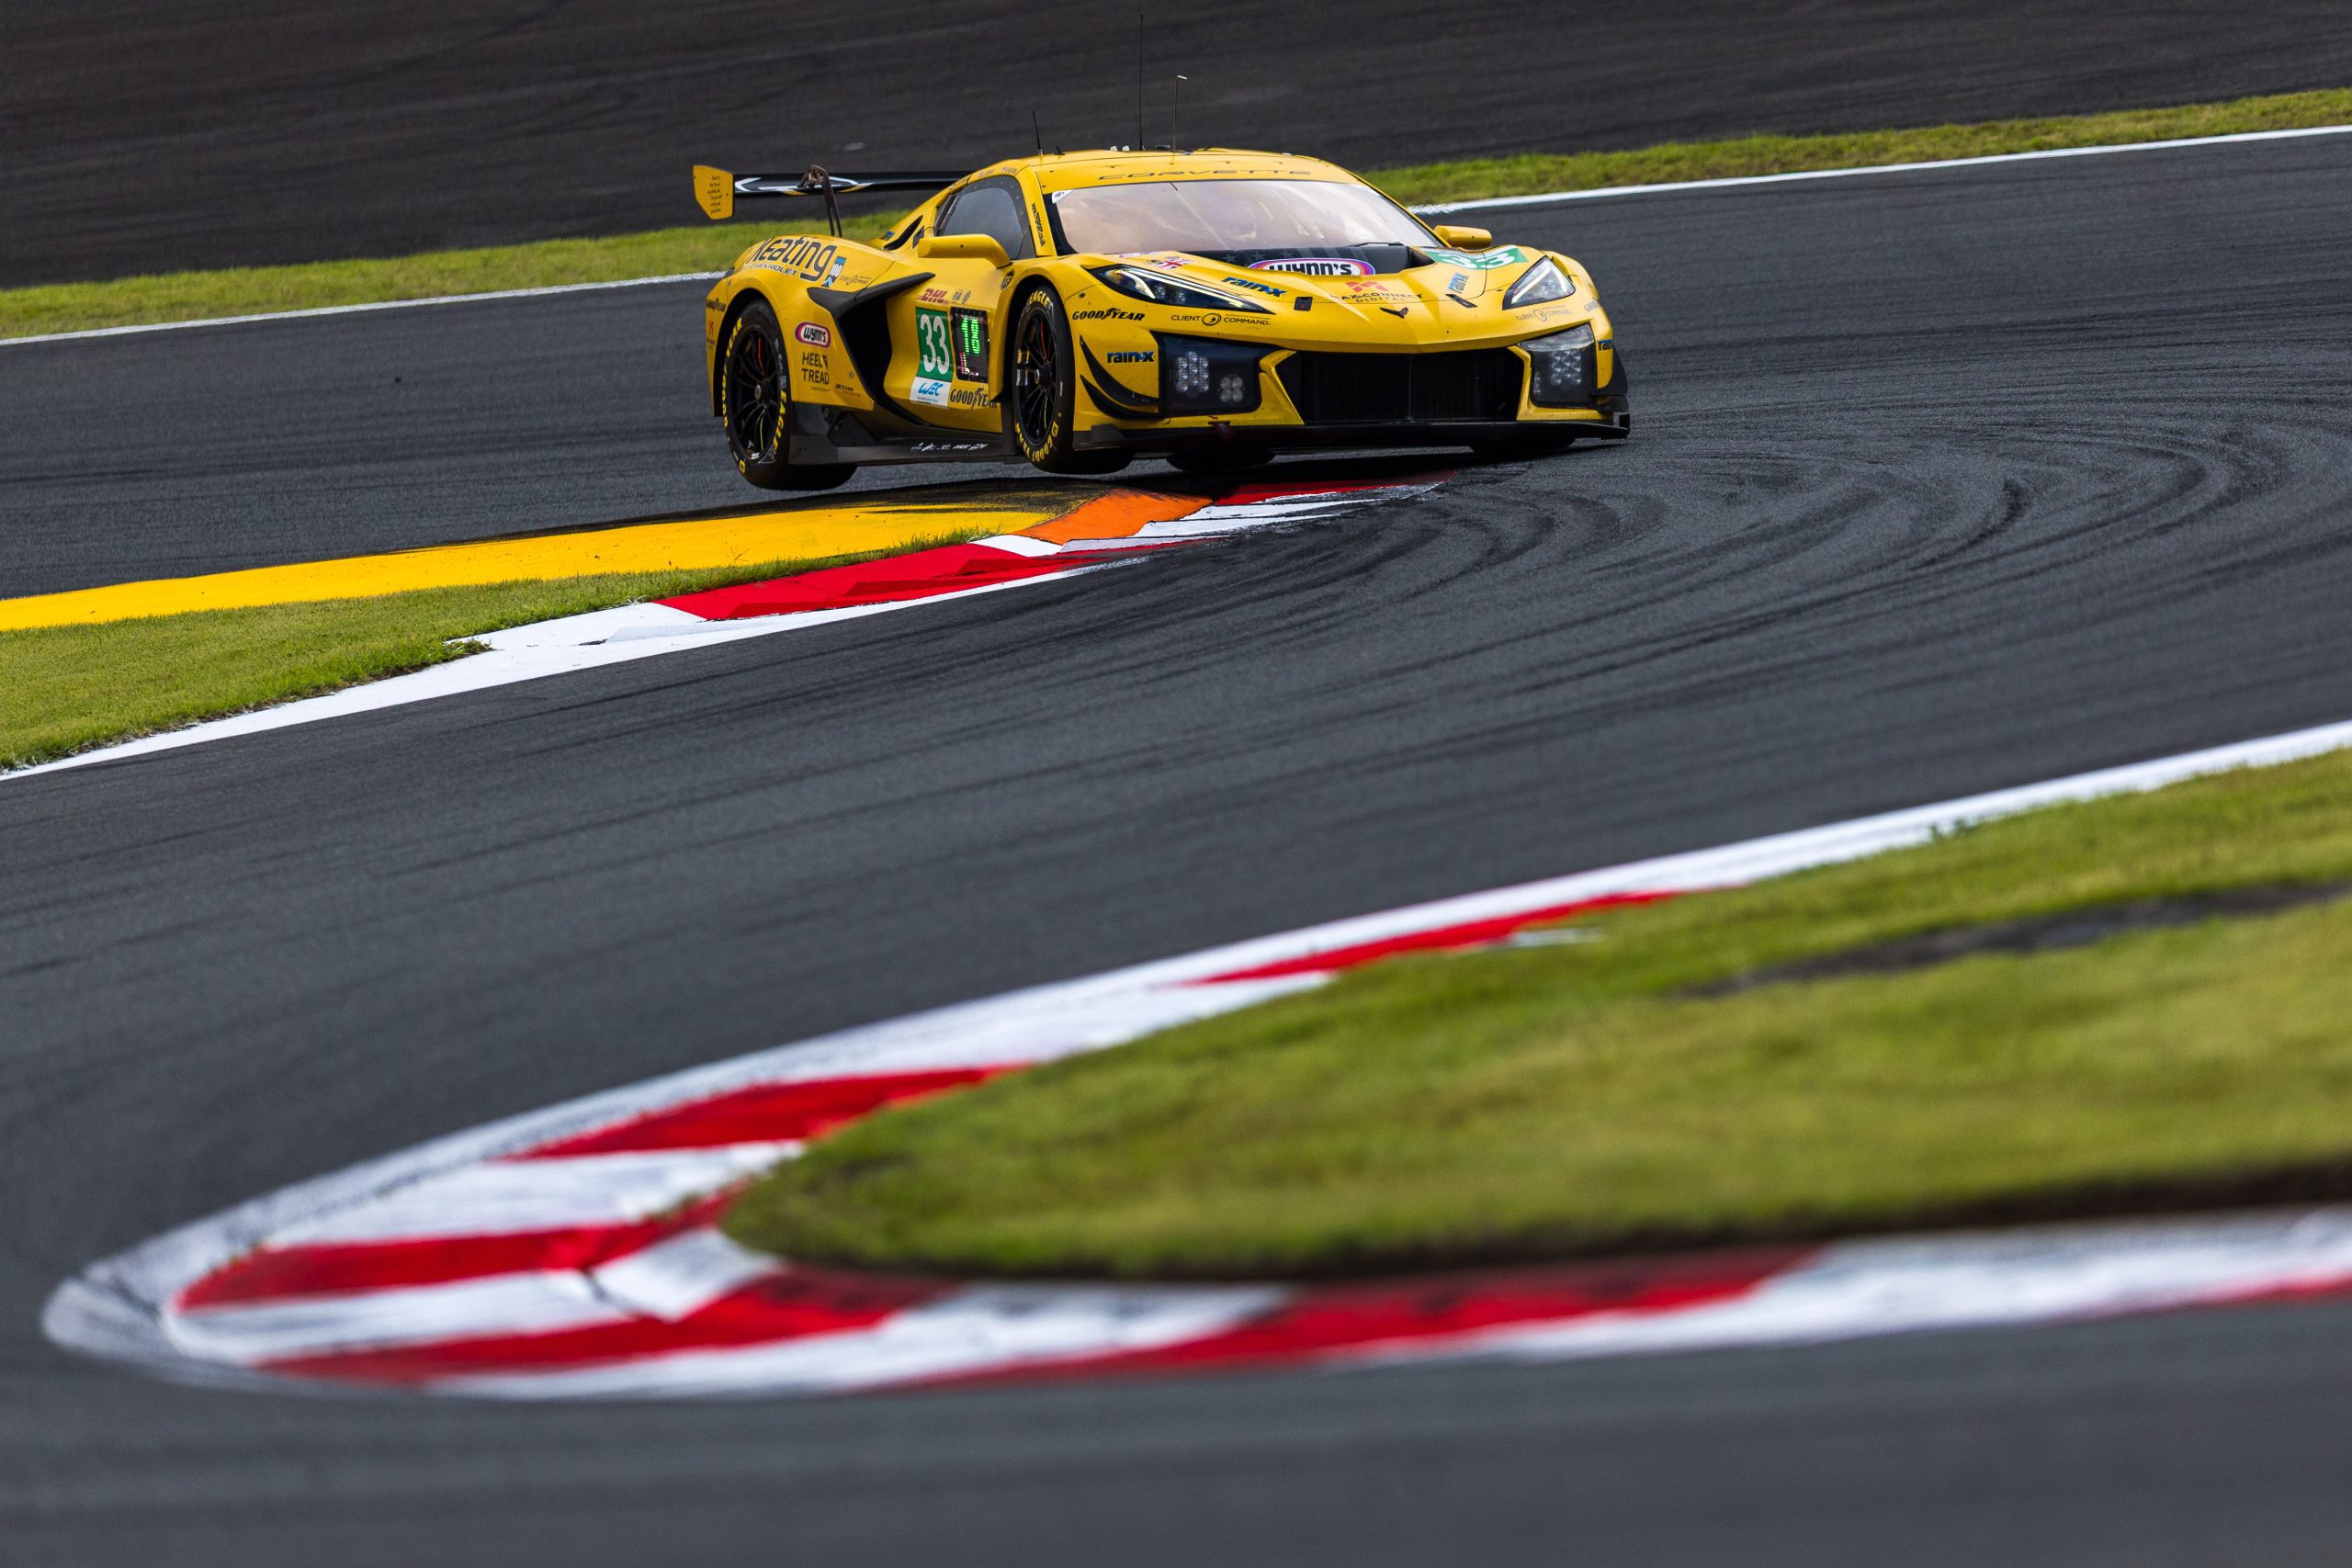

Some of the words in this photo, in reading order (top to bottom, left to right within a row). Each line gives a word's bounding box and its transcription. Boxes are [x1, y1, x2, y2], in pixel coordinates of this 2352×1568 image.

[1098, 170, 1312, 181] CORVETTE
[746, 236, 838, 282] Keating
[1436, 250, 1516, 269] 33
[1029, 290, 1050, 309] EAGLE
[1072, 307, 1146, 321] GOODYEAR
[920, 314, 950, 375] 33
[801, 368, 830, 385] TREAD
[919, 381, 944, 396] WEC
[772, 389, 787, 457] EAGLE
